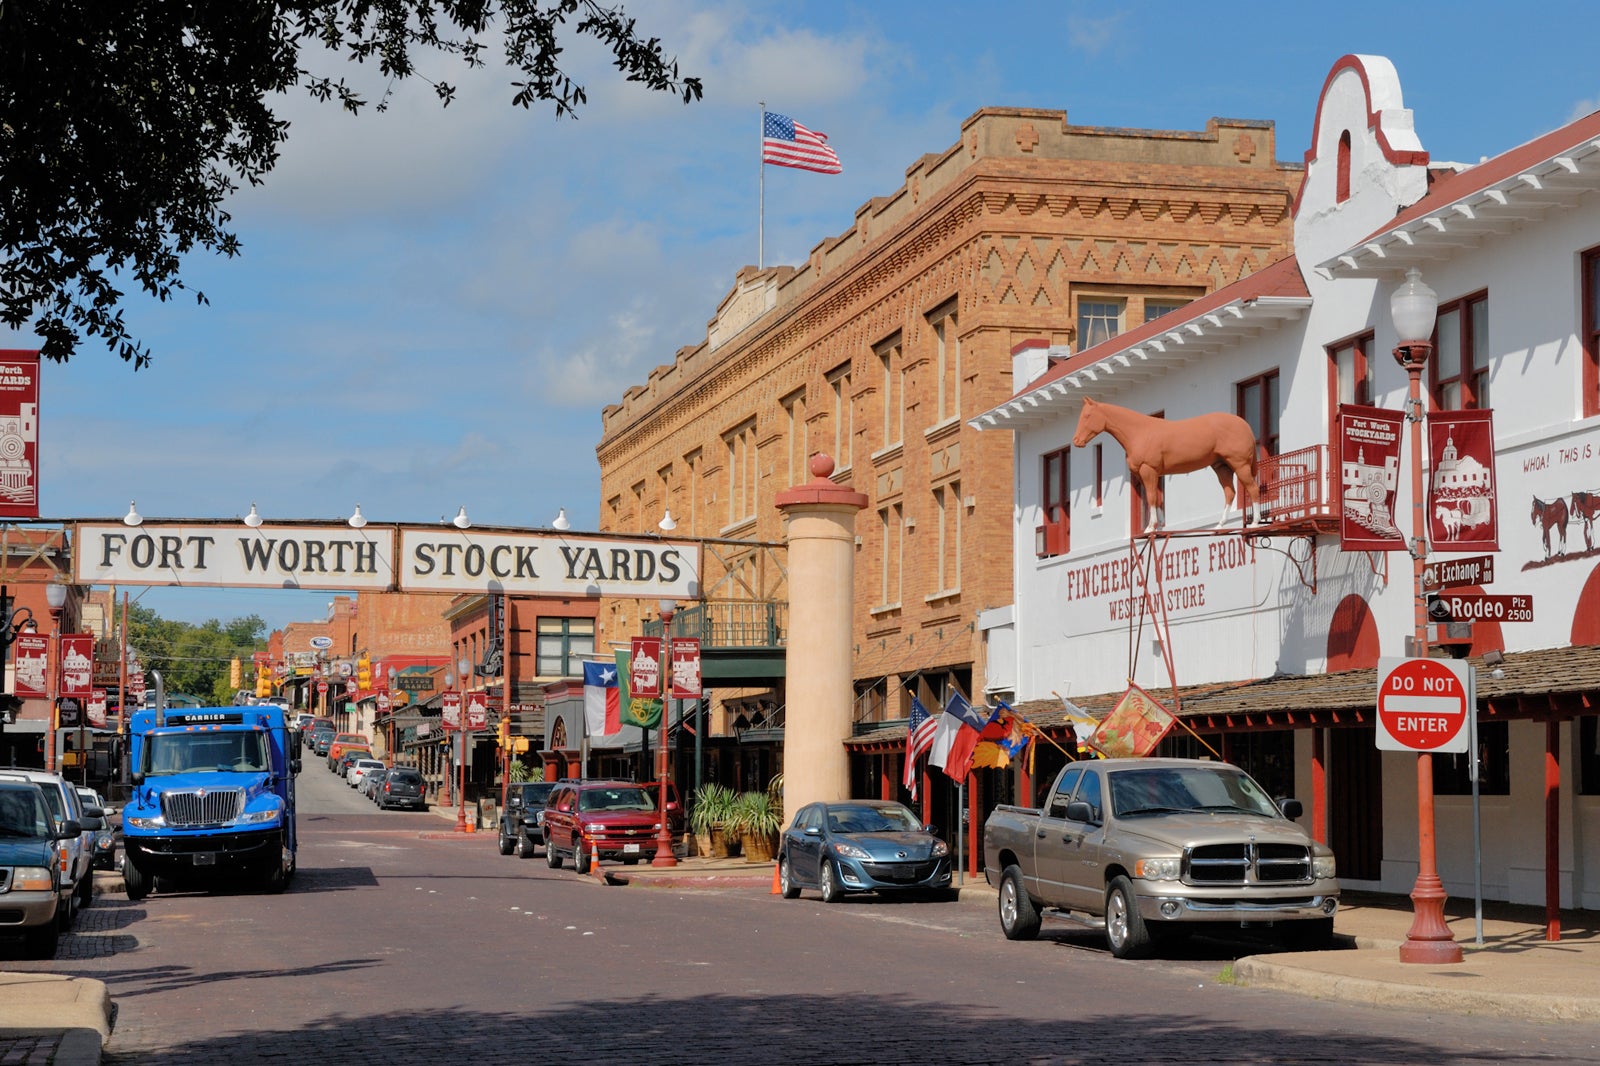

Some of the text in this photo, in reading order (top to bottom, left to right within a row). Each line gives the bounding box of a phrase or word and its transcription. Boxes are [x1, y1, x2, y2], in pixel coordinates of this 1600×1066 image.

[1353, 419, 1390, 431] Fort Worth
[1346, 427, 1396, 442] STOCKYARDS
[1523, 452, 1550, 473] WHOA!
[1559, 447, 1578, 465] THIS
[1582, 444, 1592, 460] IS
[100, 533, 681, 583] FORT WORTH STOCK YARDS
[1208, 536, 1258, 573] FRONT
[1434, 561, 1480, 585] E Exchange
[1109, 583, 1205, 621] WESTERN STORE
[1451, 597, 1504, 618] Rodeo
[1512, 597, 1526, 608] Plz
[1507, 609, 1532, 621] 2500
[1392, 676, 1454, 692] DO NOT
[1397, 717, 1448, 732] ENTER
